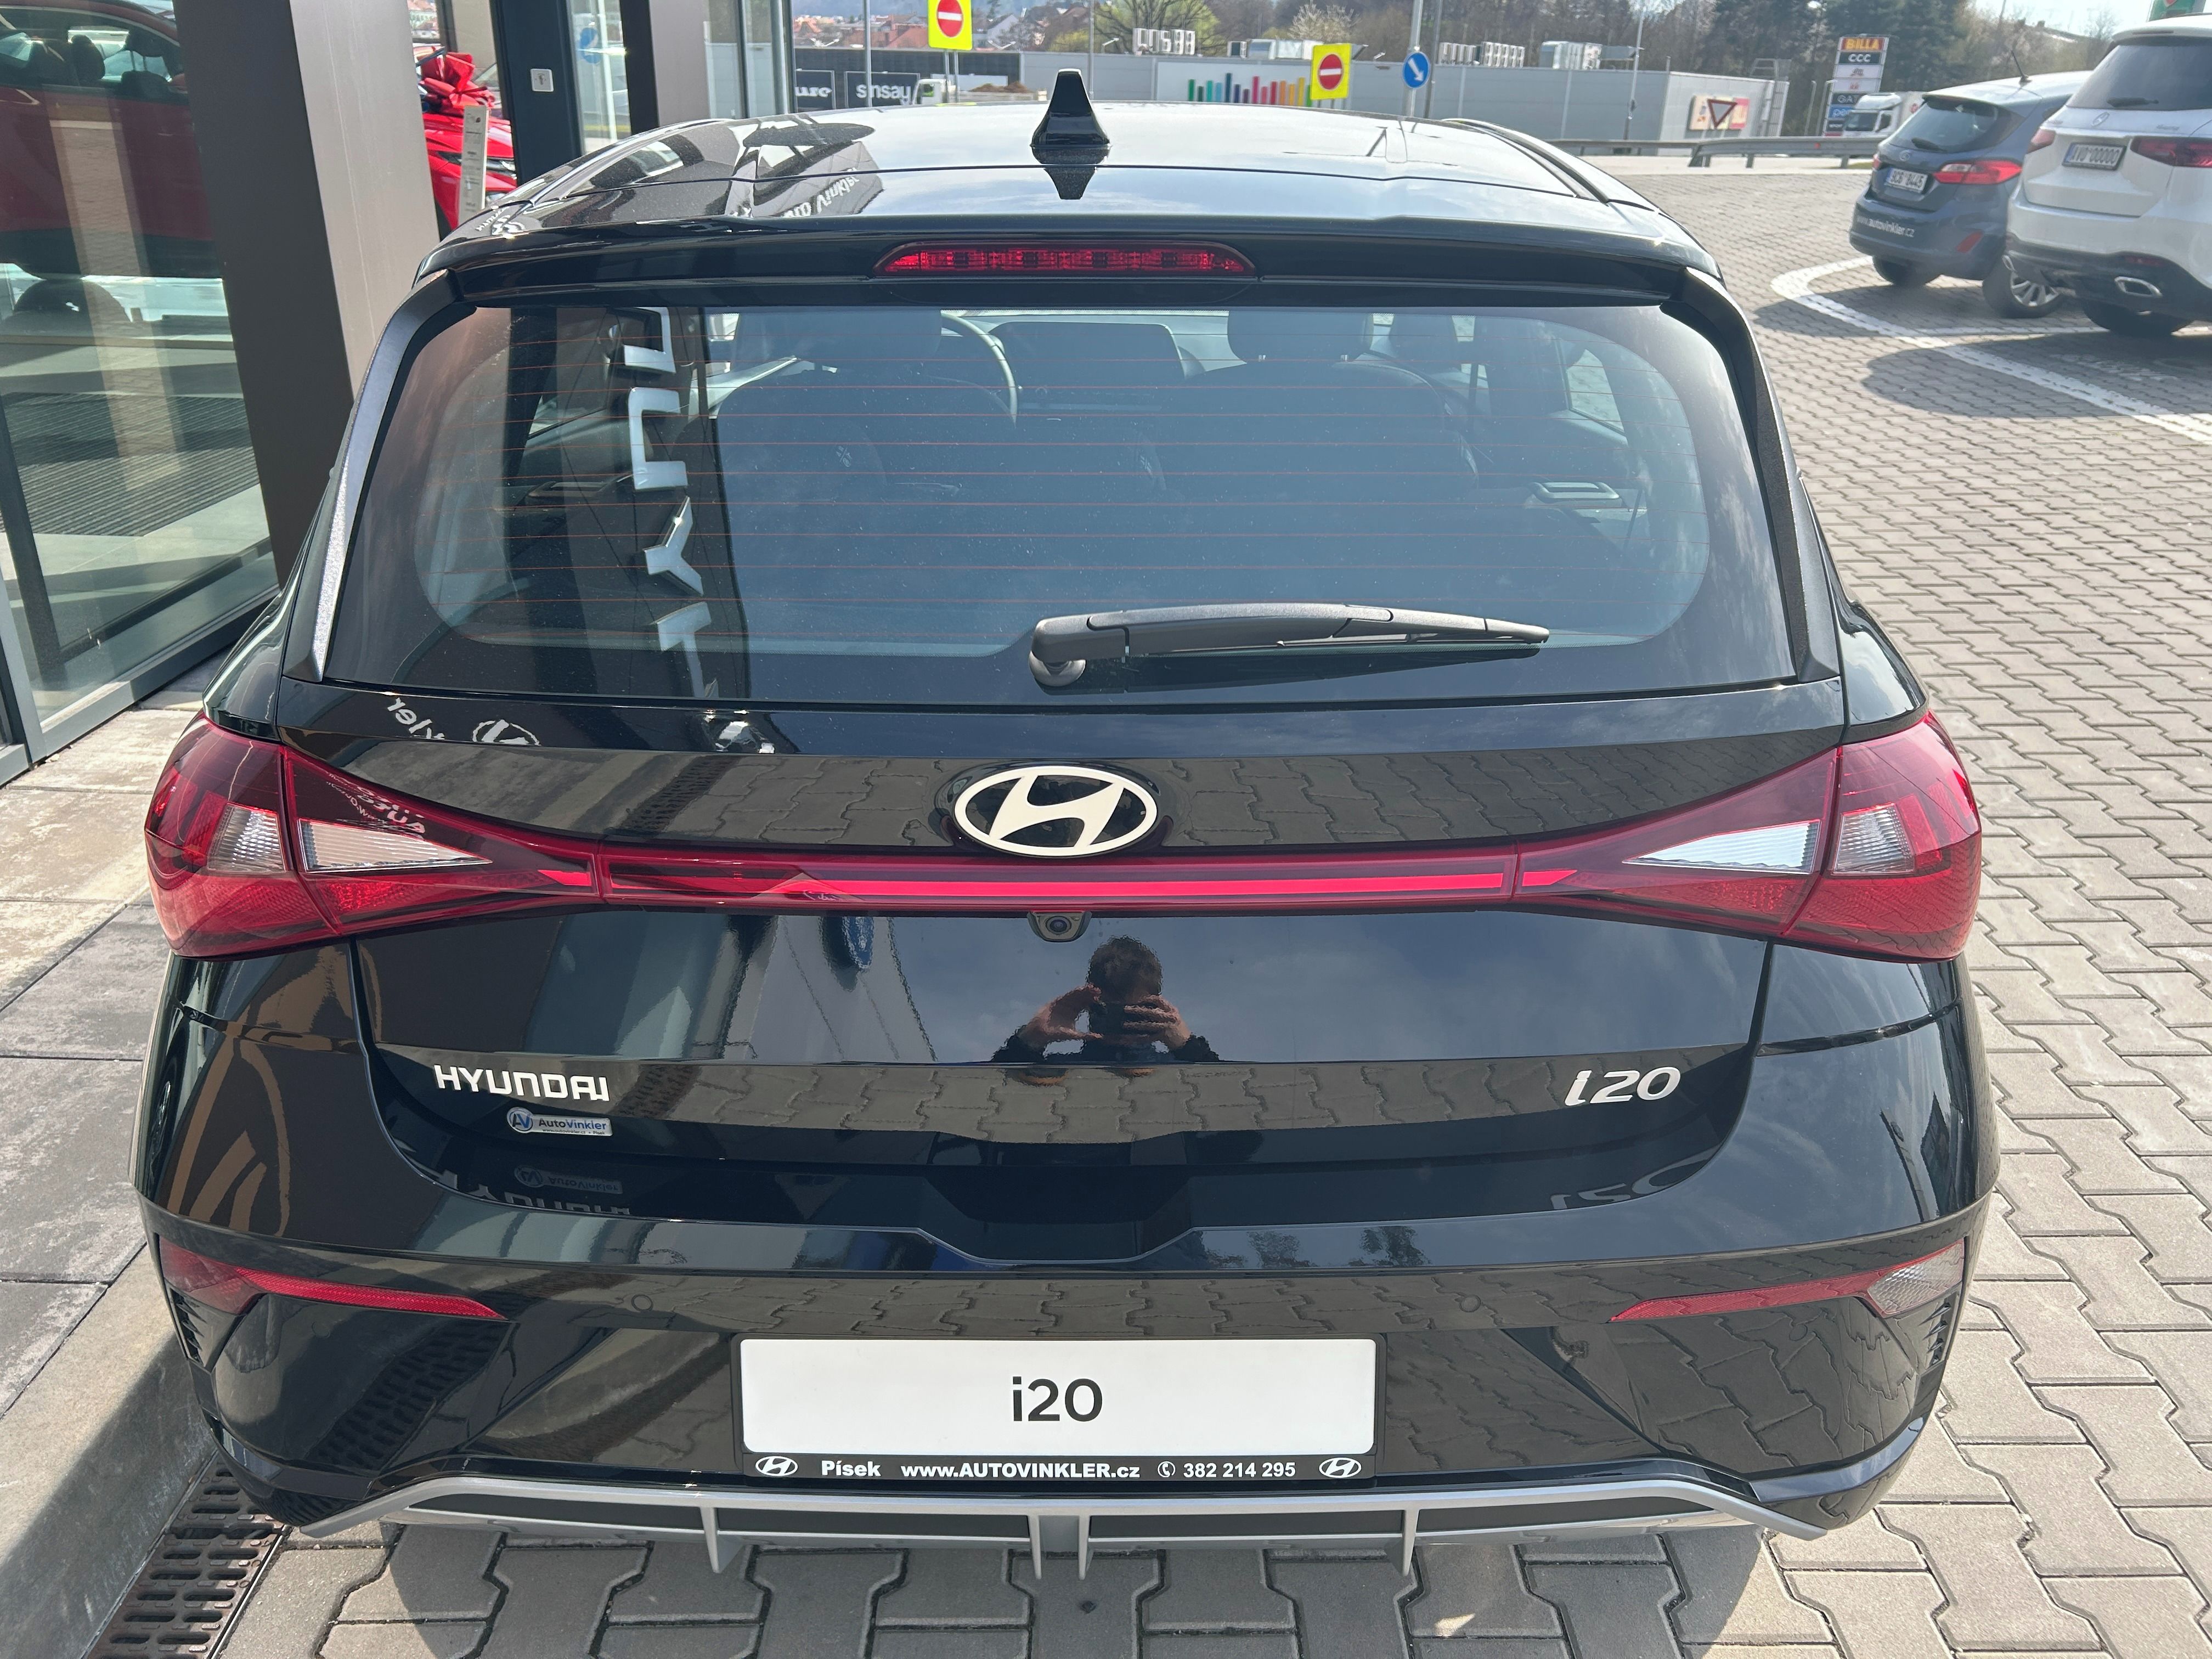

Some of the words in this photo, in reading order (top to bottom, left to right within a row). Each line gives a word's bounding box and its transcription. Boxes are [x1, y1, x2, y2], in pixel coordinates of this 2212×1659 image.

[1846, 38, 1880, 50] BILLA
[1848, 54, 1871, 63] CCC
[856, 84, 911, 104] snsay
[434, 1065, 610, 1101] HYUNDAI
[1564, 1066, 1681, 1106] i20
[538, 1117, 606, 1130] AutoVinkler
[1013, 1376, 1103, 1422] i20
[821, 1459, 881, 1477] Písek
[900, 1462, 1140, 1478] www.AUTOVINKLER.cz
[1183, 1462, 1217, 1478] 382
[1222, 1462, 1257, 1478] 214
[1262, 1462, 1296, 1477] 295
